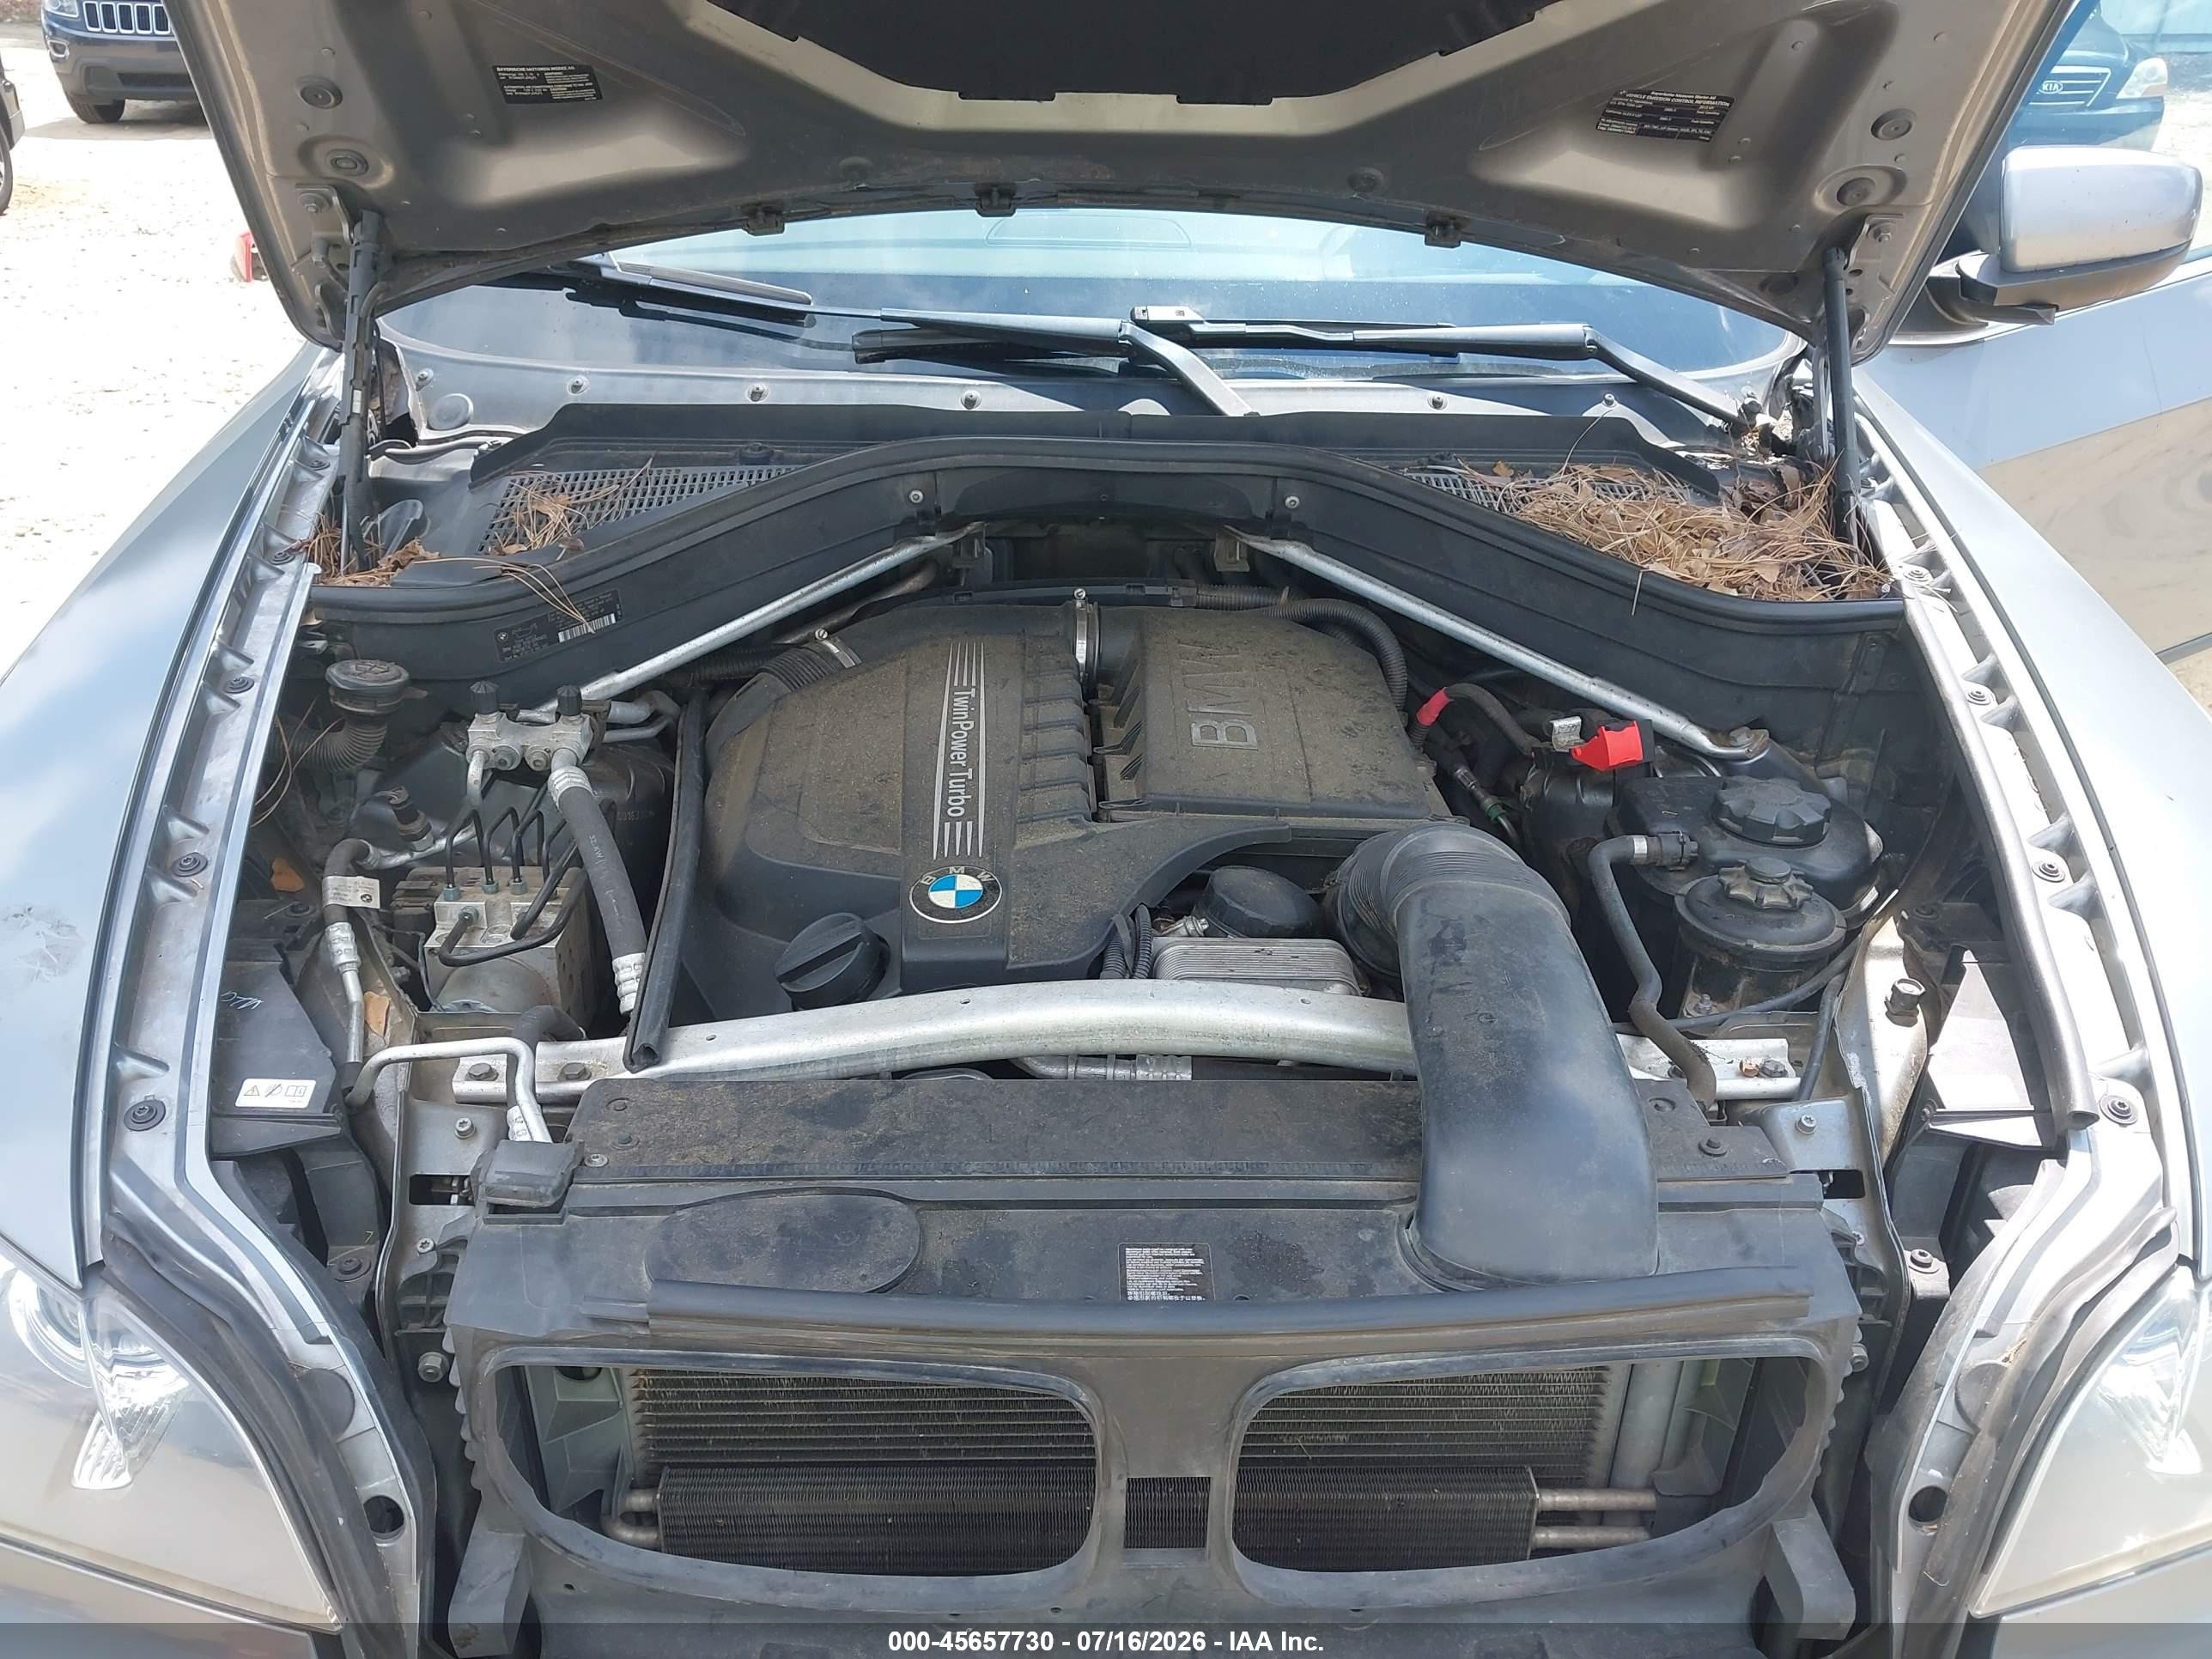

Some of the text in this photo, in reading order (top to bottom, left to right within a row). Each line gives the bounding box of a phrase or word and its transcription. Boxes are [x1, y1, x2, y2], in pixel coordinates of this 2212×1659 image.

[2042, 82, 2059, 91] KIA
[946, 687, 976, 817] TwinPower Turbo
[921, 865, 994, 886] BMW
